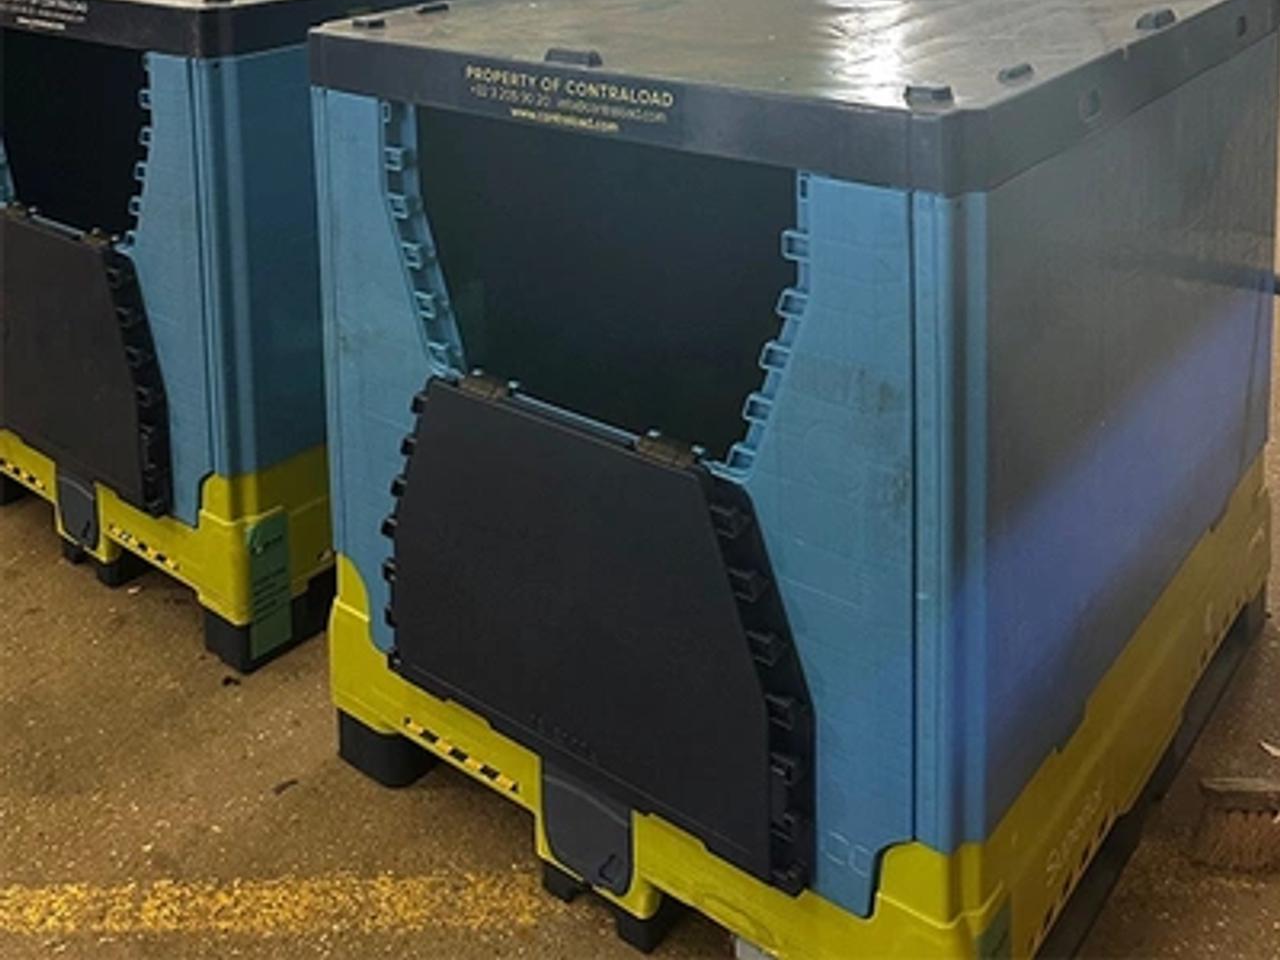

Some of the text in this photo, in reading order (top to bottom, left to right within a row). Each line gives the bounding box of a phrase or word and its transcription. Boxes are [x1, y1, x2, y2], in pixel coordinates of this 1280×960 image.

[465, 64, 674, 108] PROPERTY OF CONTRALOAD
